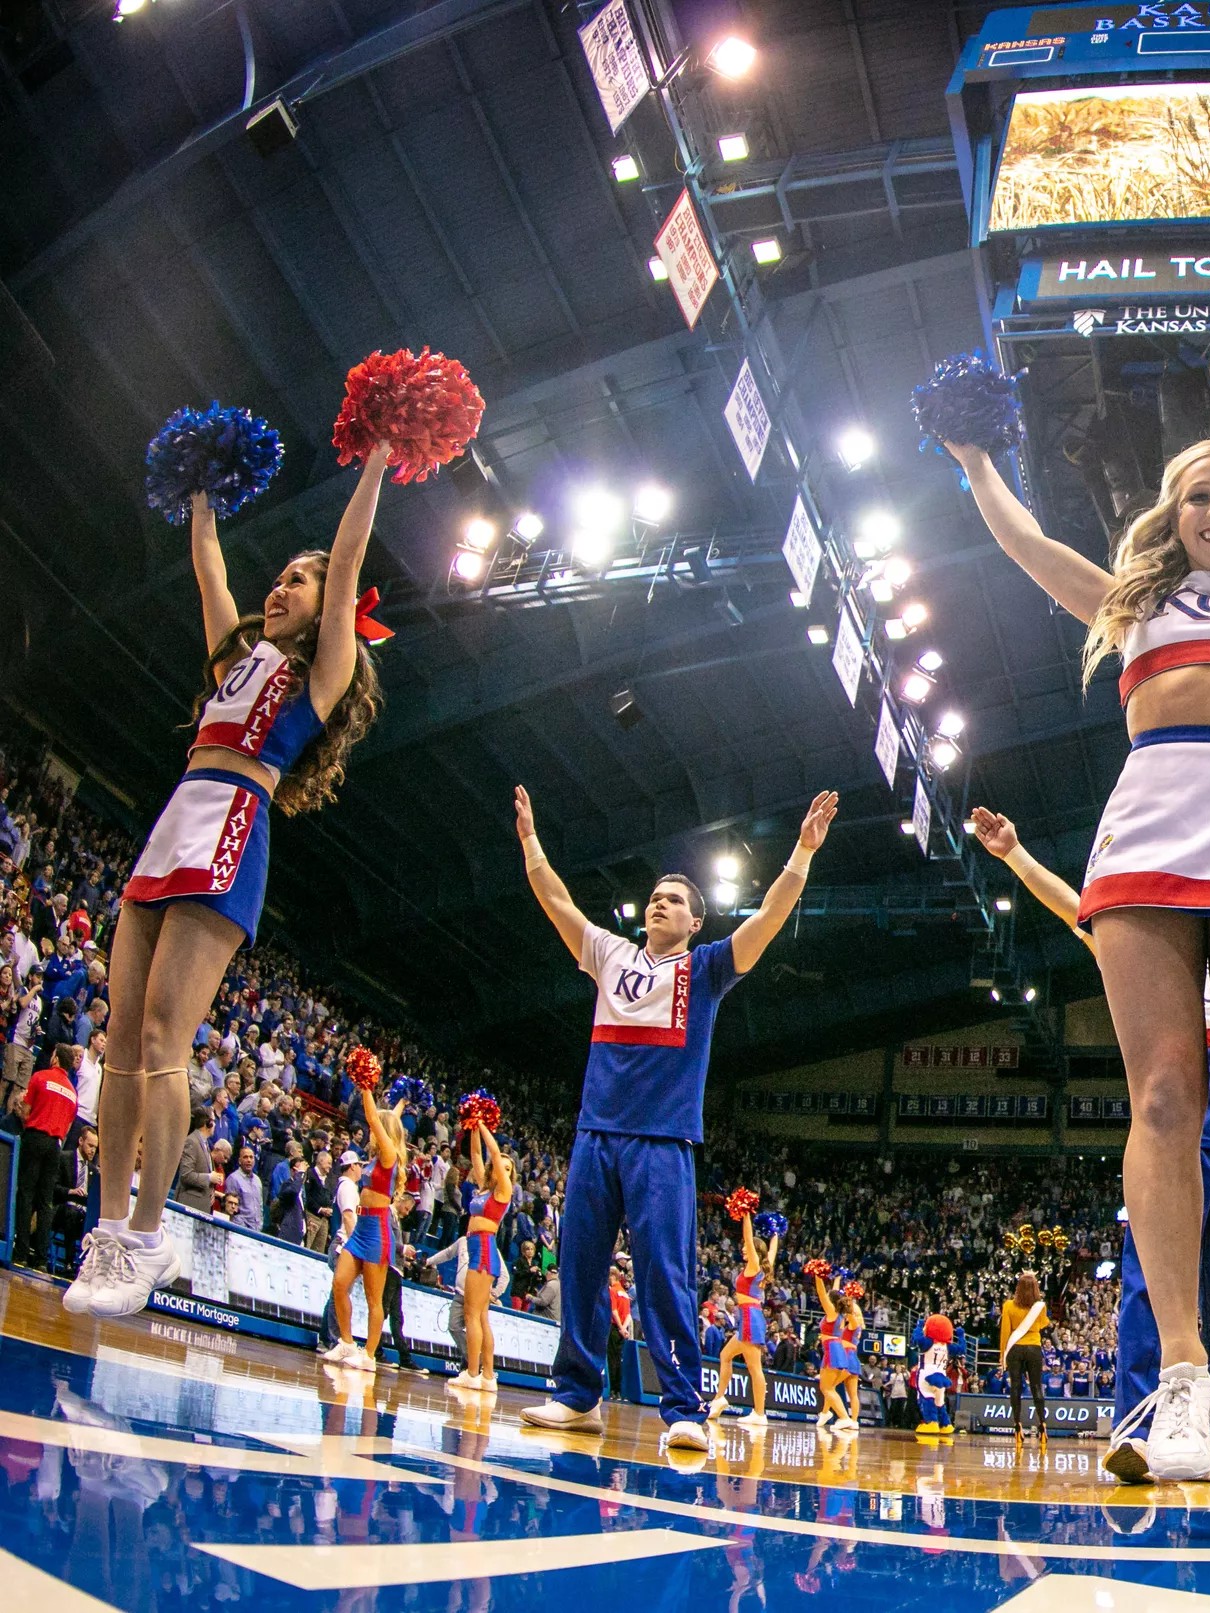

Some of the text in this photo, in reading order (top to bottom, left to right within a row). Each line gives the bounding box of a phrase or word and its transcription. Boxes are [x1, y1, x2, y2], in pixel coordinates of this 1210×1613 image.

[984, 37, 1066, 51] KANSAS
[1058, 258, 1156, 281] HAIL
[1119, 306, 1167, 320] THE
[1115, 319, 1207, 334] KANSAS
[240, 675, 290, 751] CHALK
[209, 791, 253, 892] JAYHAWK
[613, 968, 658, 1003] KU
[675, 975, 689, 1030] CHALK
[154, 1291, 239, 1327] ROCKET Mortgage
[873, 1341, 880, 1352] 0
[774, 1381, 817, 1407] KANSAS
[983, 1404, 1013, 1419] HAI
[1055, 1407, 1089, 1421] OLD
